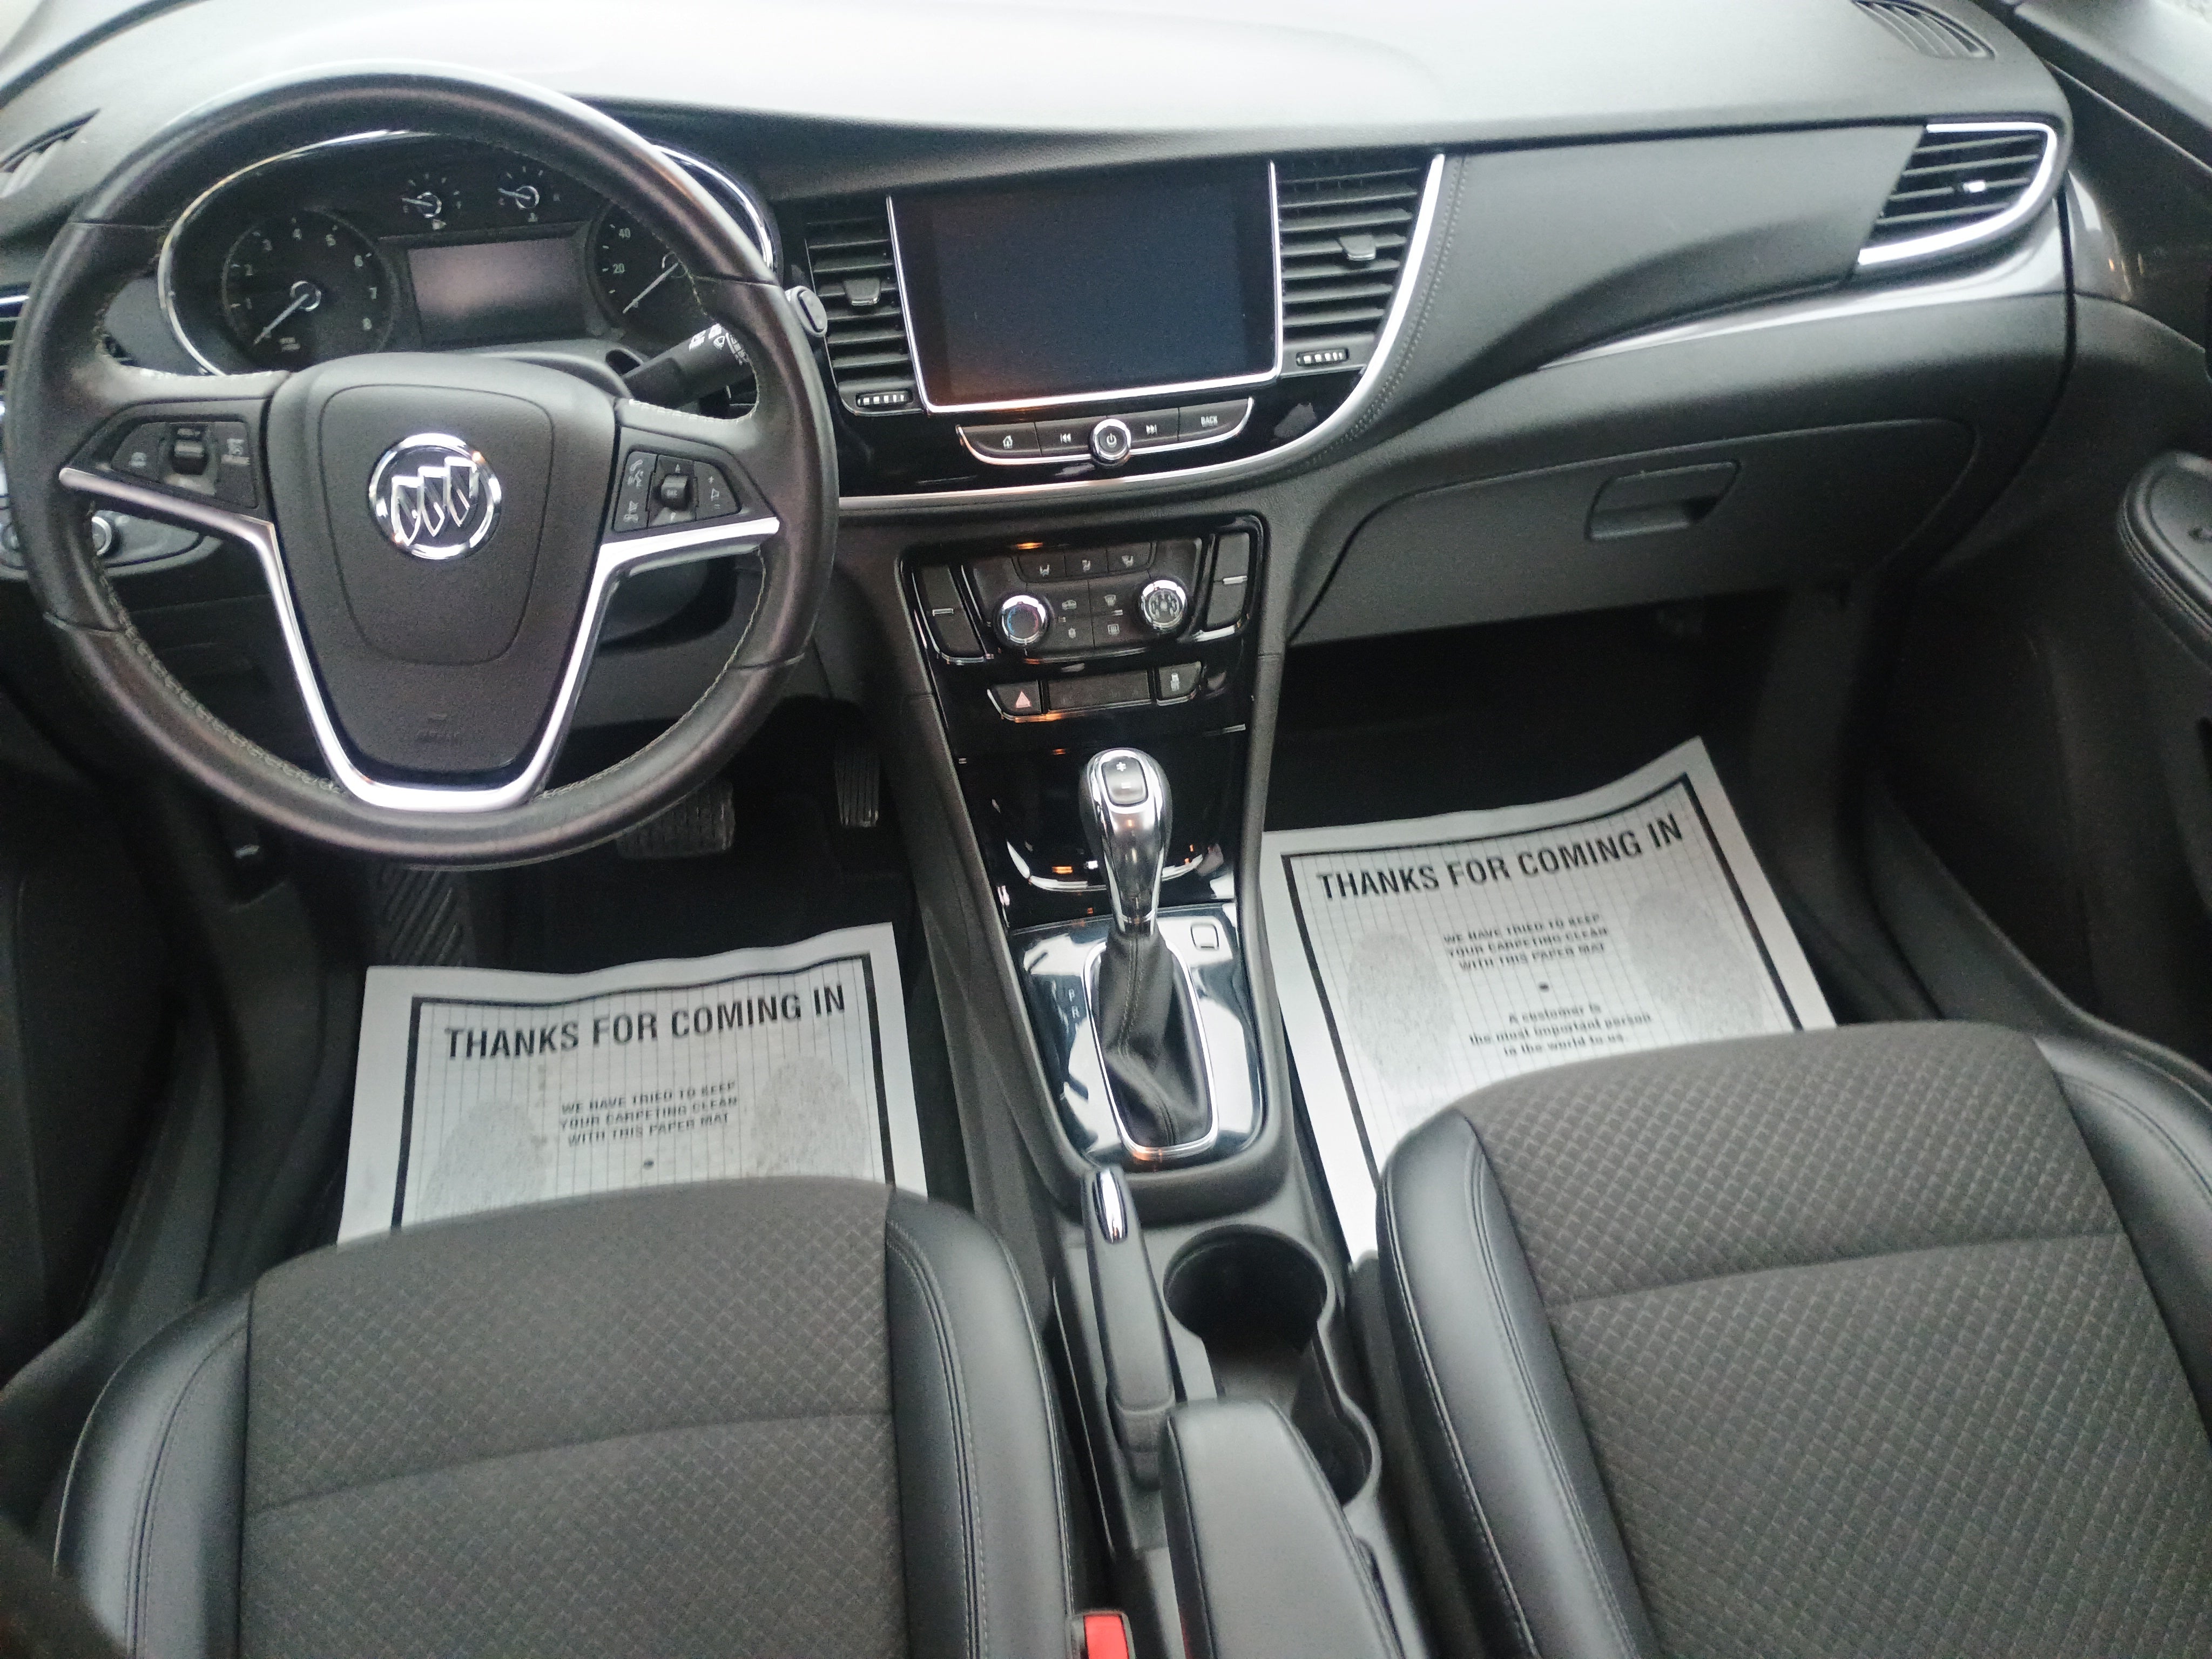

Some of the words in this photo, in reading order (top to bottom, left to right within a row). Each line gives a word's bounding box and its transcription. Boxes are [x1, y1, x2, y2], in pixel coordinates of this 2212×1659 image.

[618, 227, 631, 238] 40
[613, 263, 625, 274] 20
[1201, 415, 1218, 428] BACK
[1316, 864, 1439, 899] THANKS
[1446, 855, 1510, 886] FOR
[1517, 830, 1642, 875] COMING
[1648, 812, 1683, 848] IN
[1444, 933, 1462, 943] WE
[1548, 919, 1564, 929] TO
[1459, 957, 1494, 971] WITH
[1499, 954, 1529, 966] THIS
[1532, 947, 1575, 960] PAPER
[1068, 989, 1075, 1002] P
[444, 1021, 579, 1060] THANKS
[592, 1010, 658, 1047] FOR
[671, 993, 801, 1039] COMING
[813, 984, 845, 1016] IN
[1071, 1006, 1080, 1019] R
[1522, 1007, 1584, 1022] customer
[1469, 1034, 1492, 1046] the
[1496, 1027, 1529, 1041] most
[1533, 1018, 1601, 1037] important
[1520, 1043, 1543, 1054] the
[1547, 1035, 1586, 1050] world
[1590, 1035, 1603, 1044] to
[562, 1102, 584, 1115] WE
[589, 1096, 626, 1111] HAVE
[632, 1088, 673, 1105] TRIED
[679, 1085, 696, 1100] TO
[701, 1079, 736, 1096] KEEP
[560, 1115, 600, 1131] YOUR
[605, 1104, 687, 1125] CARPETING
[692, 1096, 738, 1114] CLEAN
[568, 1130, 605, 1148] WITH
[613, 1124, 643, 1140] THIS
[649, 1117, 695, 1137] PAPER
[700, 1112, 729, 1126] MAT
